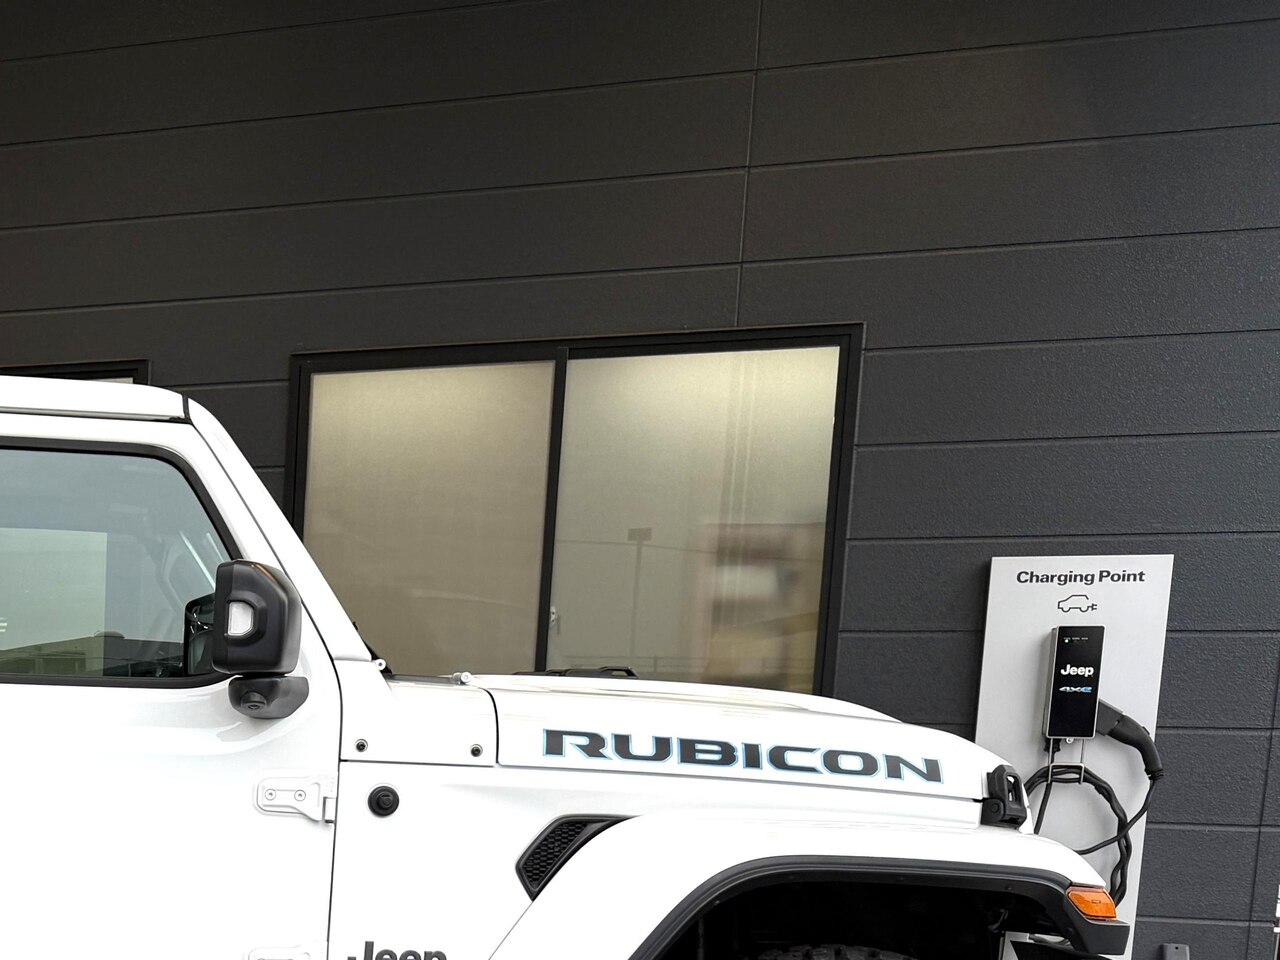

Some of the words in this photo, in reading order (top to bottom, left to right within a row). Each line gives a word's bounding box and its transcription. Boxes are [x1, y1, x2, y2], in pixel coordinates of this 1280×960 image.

[1016, 571, 1095, 586] Charging
[1098, 569, 1146, 583] Point
[1060, 664, 1094, 678] Jeep
[542, 728, 944, 783] RUBICON
